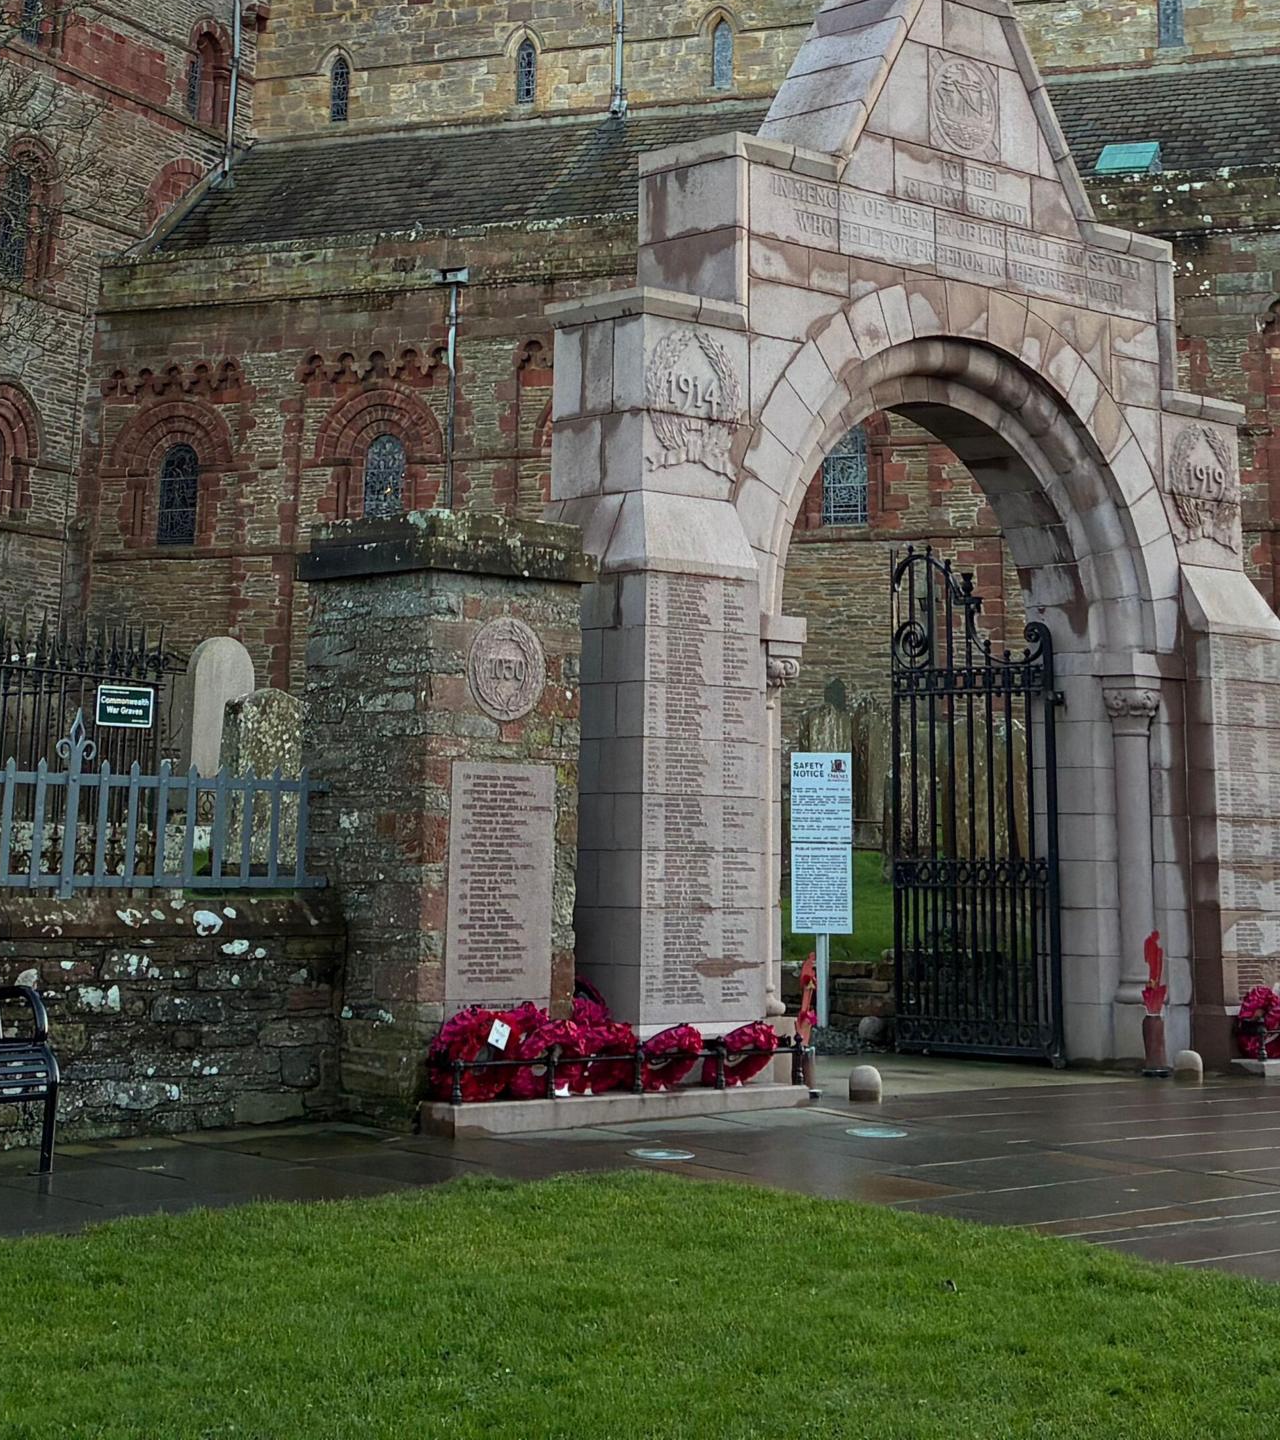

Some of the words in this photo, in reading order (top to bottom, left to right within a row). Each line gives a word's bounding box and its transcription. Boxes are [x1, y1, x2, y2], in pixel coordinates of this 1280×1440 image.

[942, 161, 961, 180] TO
[966, 167, 995, 190] THE
[772, 174, 790, 197] IN
[792, 179, 858, 215] MEMORY
[863, 199, 884, 220] OF
[888, 203, 919, 229] THE
[921, 210, 953, 238] MEN
[955, 219, 975, 241] OF
[977, 224, 1048, 259] KIRKWALL
[905, 180, 962, 209] GLORY
[966, 194, 987, 216] OF
[991, 200, 1027, 226] GOD
[794, 210, 833, 238] WHO
[839, 222, 876, 250] FELL
[880, 230, 911, 258] FOR
[916, 239, 983, 272] FREEDOM
[988, 259, 1002, 278] IN
[1011, 262, 1034, 284] THE
[1036, 268, 1085, 298] GREAT
[1088, 279, 1120, 304] WAR
[666, 370, 722, 418] 1914
[1186, 462, 1226, 501] 1919
[101, 695, 150, 707] Commonwealth
[106, 705, 120, 714] War
[120, 706, 144, 716] Graves
[793, 762, 824, 770] SAFETY
[793, 770, 825, 778] NOTICE
